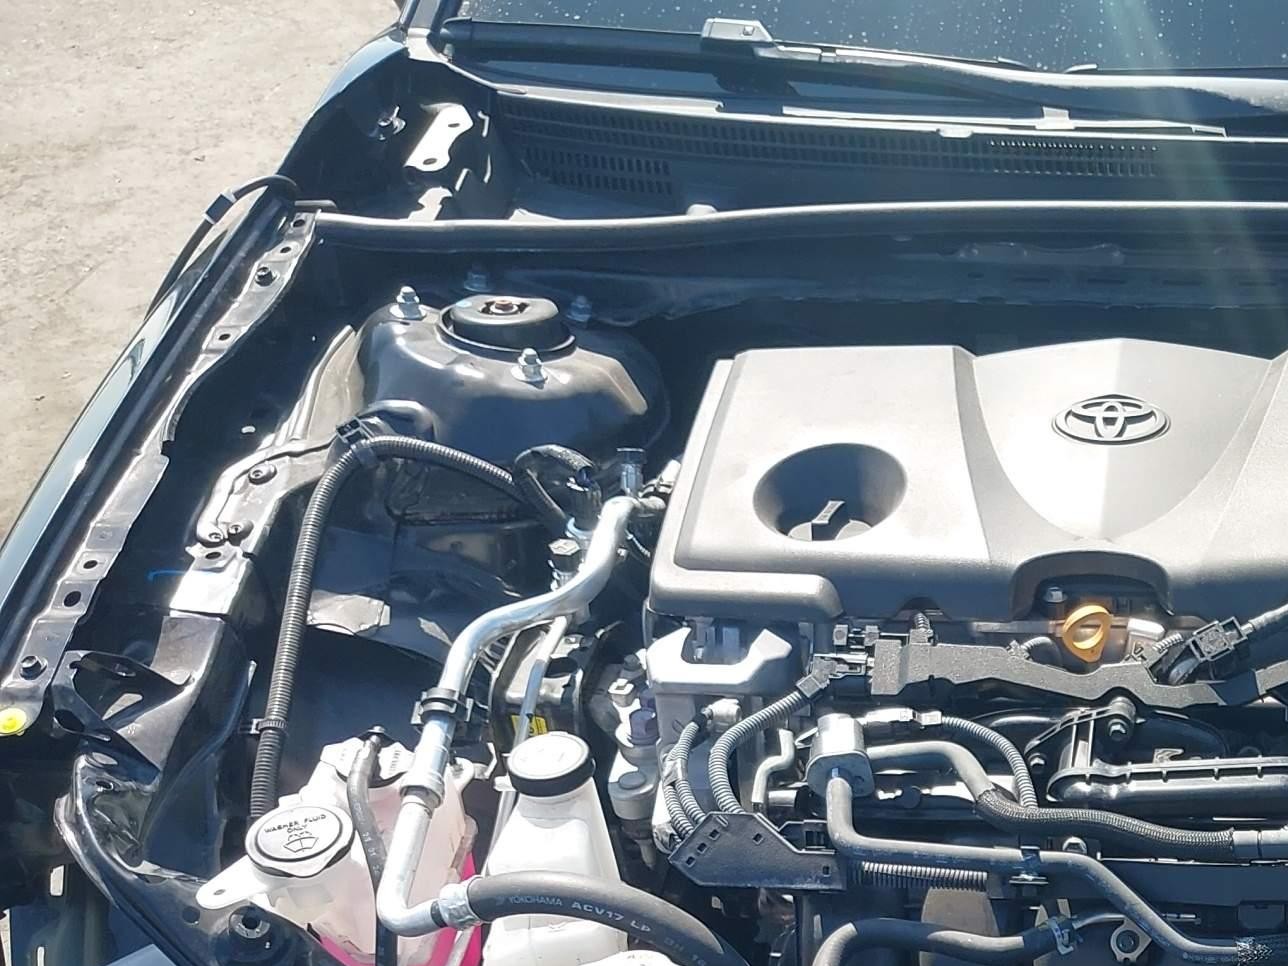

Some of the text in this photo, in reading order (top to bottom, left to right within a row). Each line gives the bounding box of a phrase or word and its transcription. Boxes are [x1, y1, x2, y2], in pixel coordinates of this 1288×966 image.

[304, 814, 327, 823] FLUID
[287, 824, 308, 833] ONLY
[509, 895, 563, 906] YOKOHAMA
[571, 901, 625, 921] ACV17
